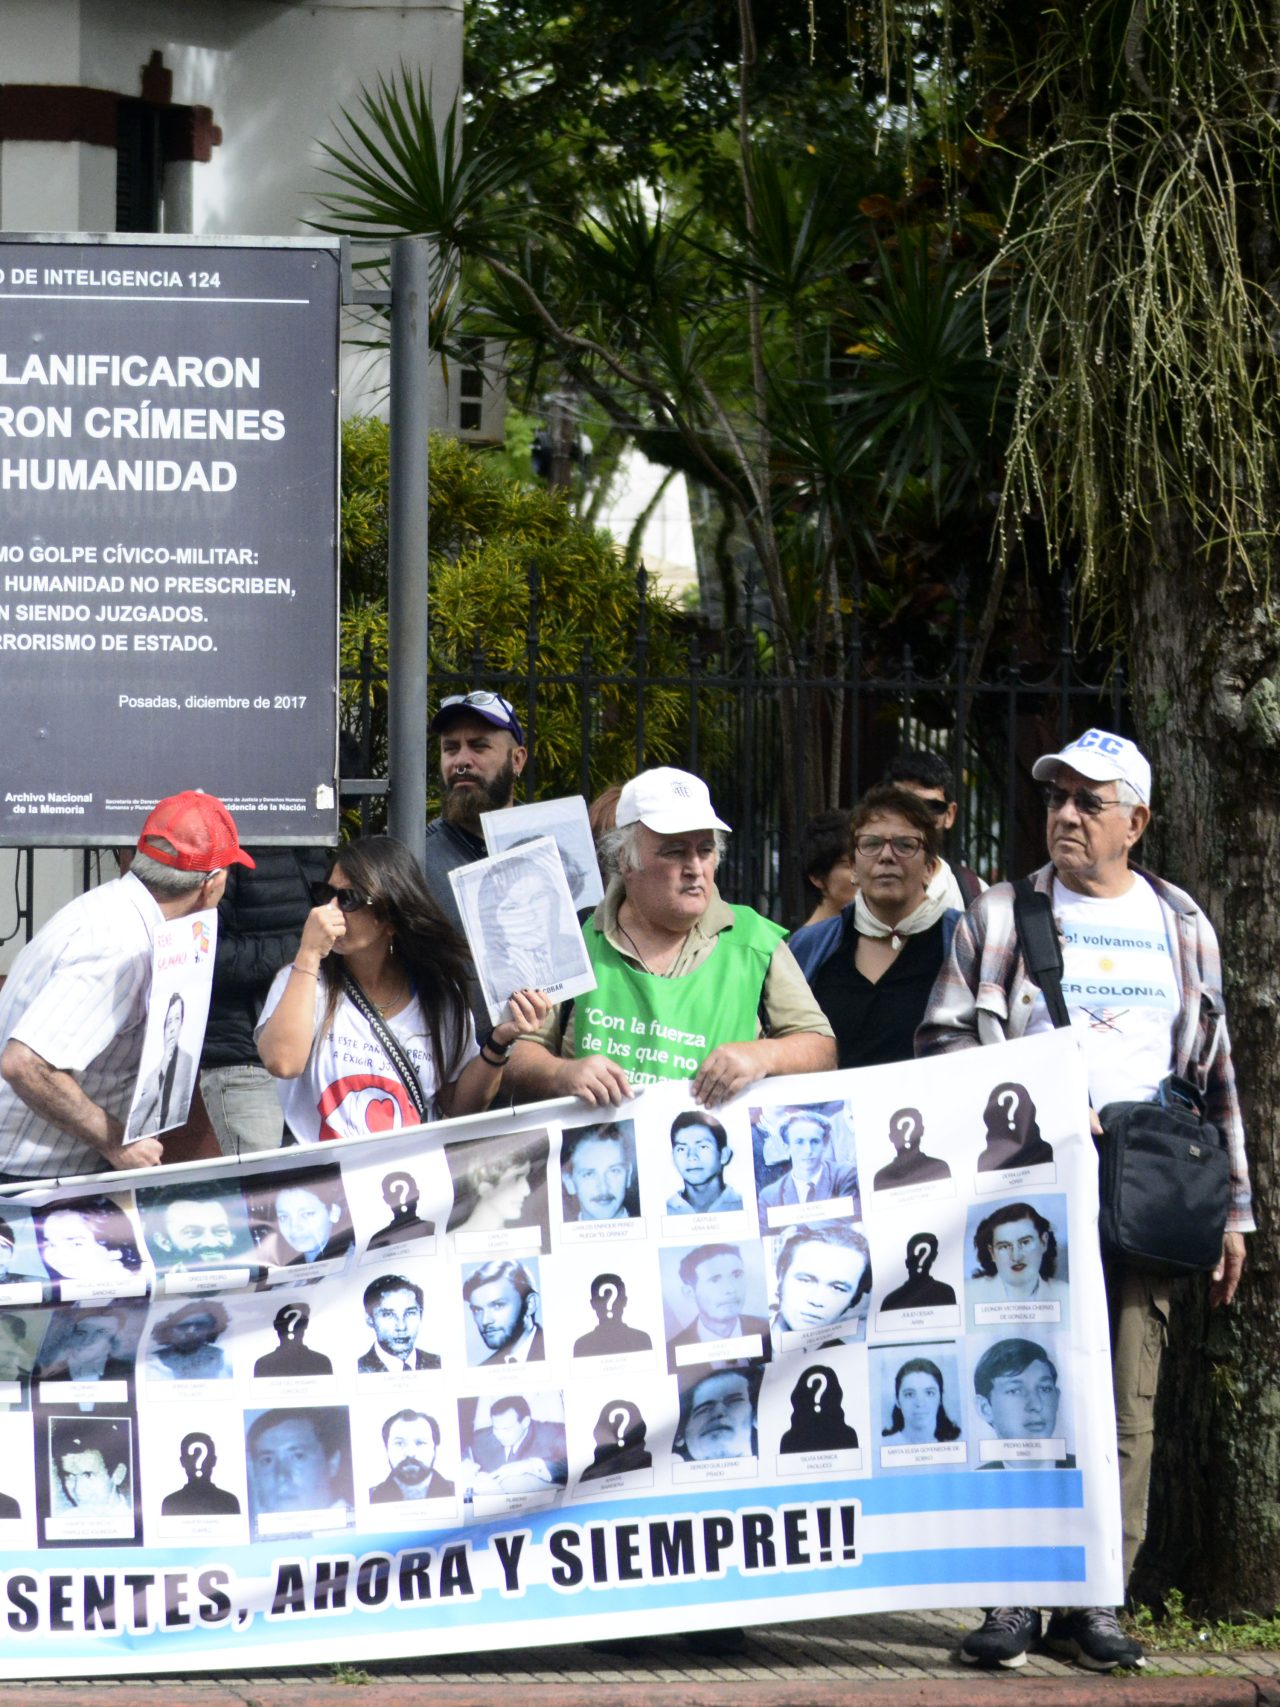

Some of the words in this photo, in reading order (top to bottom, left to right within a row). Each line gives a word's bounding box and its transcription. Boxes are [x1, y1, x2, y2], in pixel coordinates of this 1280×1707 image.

[11, 269, 37, 285] DE
[44, 269, 183, 287] INTELIGENCIA
[189, 271, 220, 287] 124
[84, 399, 286, 441] CRÍMENES
[1, 459, 238, 493] HUMANIDAD
[29, 546, 97, 563] GOLPE
[103, 543, 259, 565] CÍVICO-MILITAR:
[5, 575, 124, 593] HUMANIDAD
[130, 576, 159, 593] NO
[165, 577, 296, 597] PRESCRIBEN,
[15, 604, 90, 622] SIENDO
[95, 605, 208, 623] JUZGADOS.
[101, 634, 128, 651] DE
[134, 635, 218, 652] ESTADO.
[118, 694, 181, 712] Posadas,
[184, 694, 250, 710] diciembre
[253, 695, 270, 710] de
[274, 695, 307, 710] 2017
[5, 792, 46, 803] Archivo
[47, 792, 93, 803] Nacional
[13, 804, 26, 814] de
[28, 804, 38, 814] la
[40, 804, 85, 815] Memoria
[1083, 934, 1152, 949] volvamos
[1060, 984, 1082, 993] ER
[1086, 986, 1166, 998] COLONIA
[630, 1017, 646, 1035] la
[650, 1020, 706, 1048] fuerza
[582, 1033, 602, 1051] de
[607, 1038, 631, 1057] lxs
[636, 1047, 669, 1063] que
[673, 1055, 698, 1071] no
[271, 1543, 475, 1616] AHORA
[494, 1534, 527, 1592] Y
[550, 1505, 857, 1588] SIEMPRE!!
